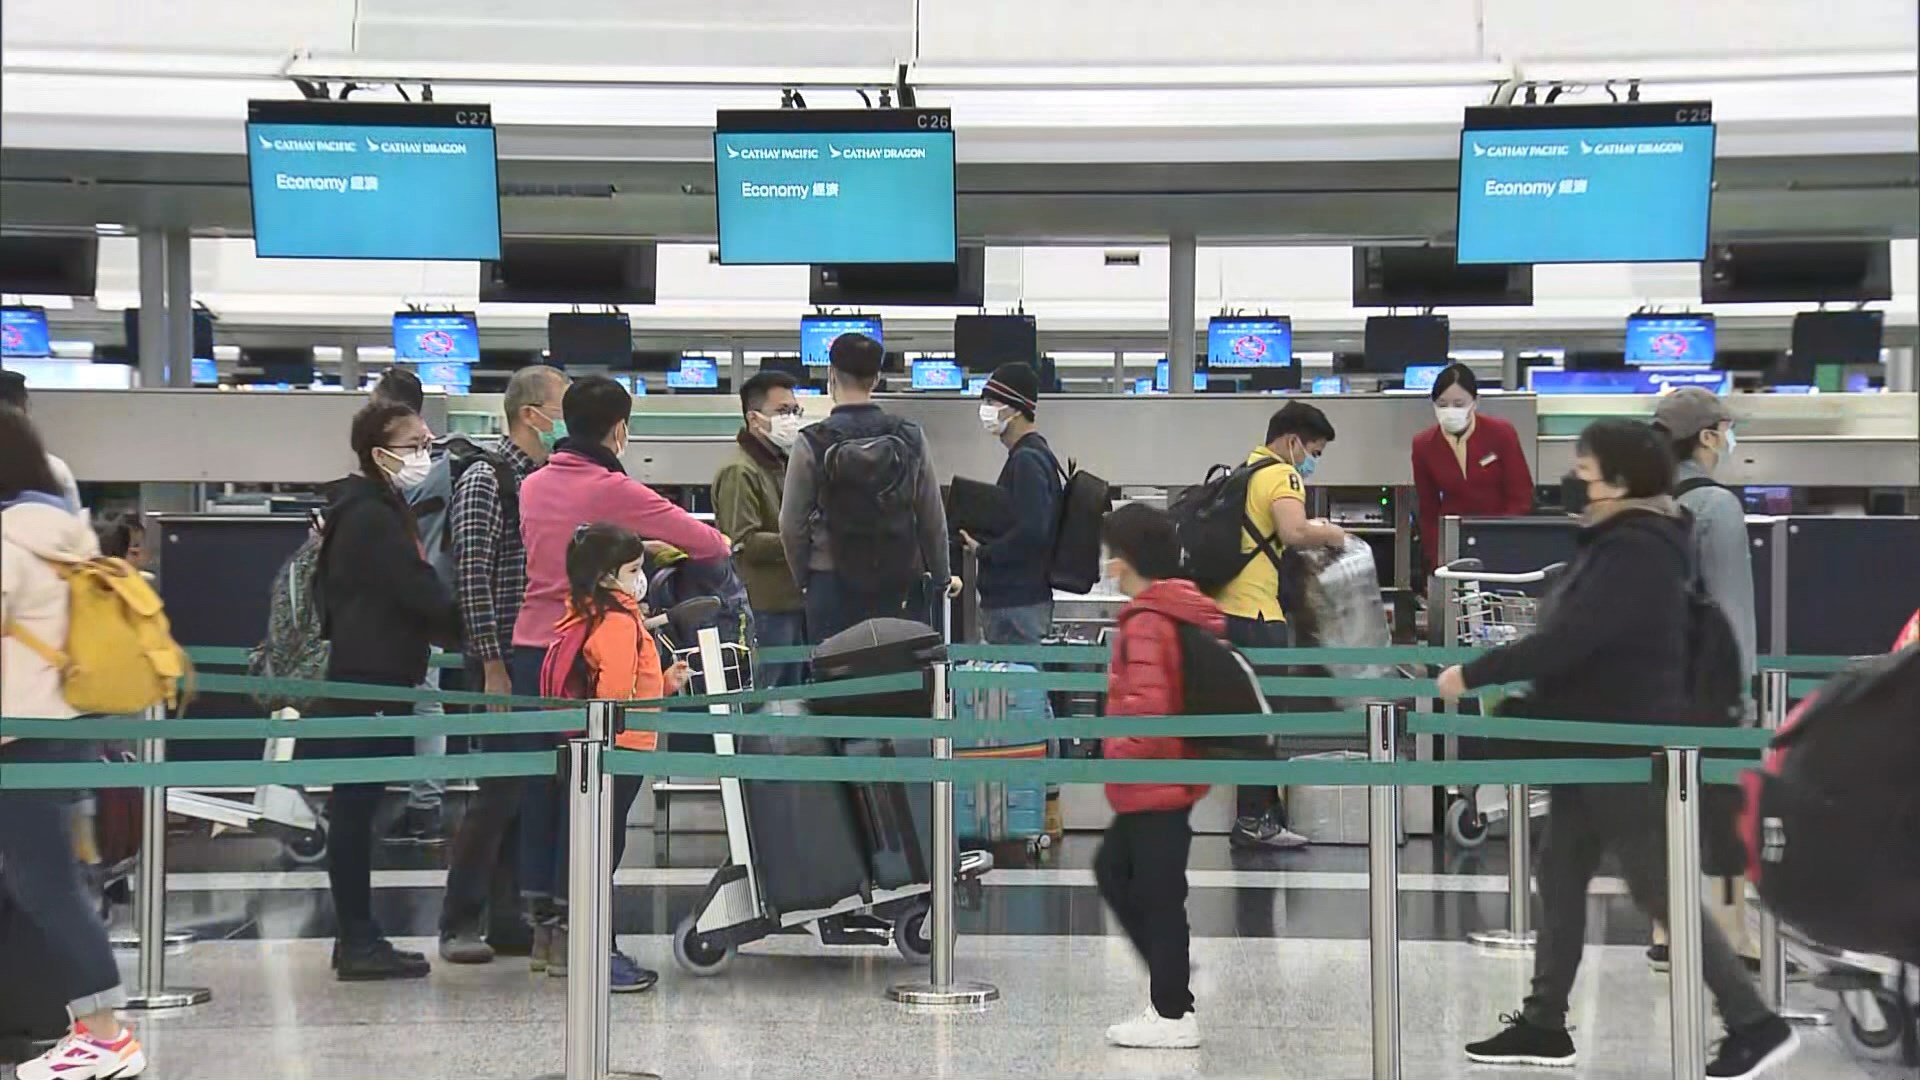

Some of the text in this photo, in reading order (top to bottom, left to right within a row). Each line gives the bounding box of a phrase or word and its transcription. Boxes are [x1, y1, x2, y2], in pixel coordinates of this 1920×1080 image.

[274, 140, 357, 153] CATHAY PACIFIC
[381, 142, 467, 154] CATHAY DRAGON
[1487, 145, 1569, 157] CATHAY PACIFIC
[1594, 141, 1684, 155] CATHAY DRAGON
[740, 148, 819, 159] CATHAY PACIFIC
[843, 148, 926, 159] CATHAY DRAGON
[276, 173, 347, 193] Economy
[1485, 179, 1557, 198] Economy
[741, 182, 809, 199] Economy
